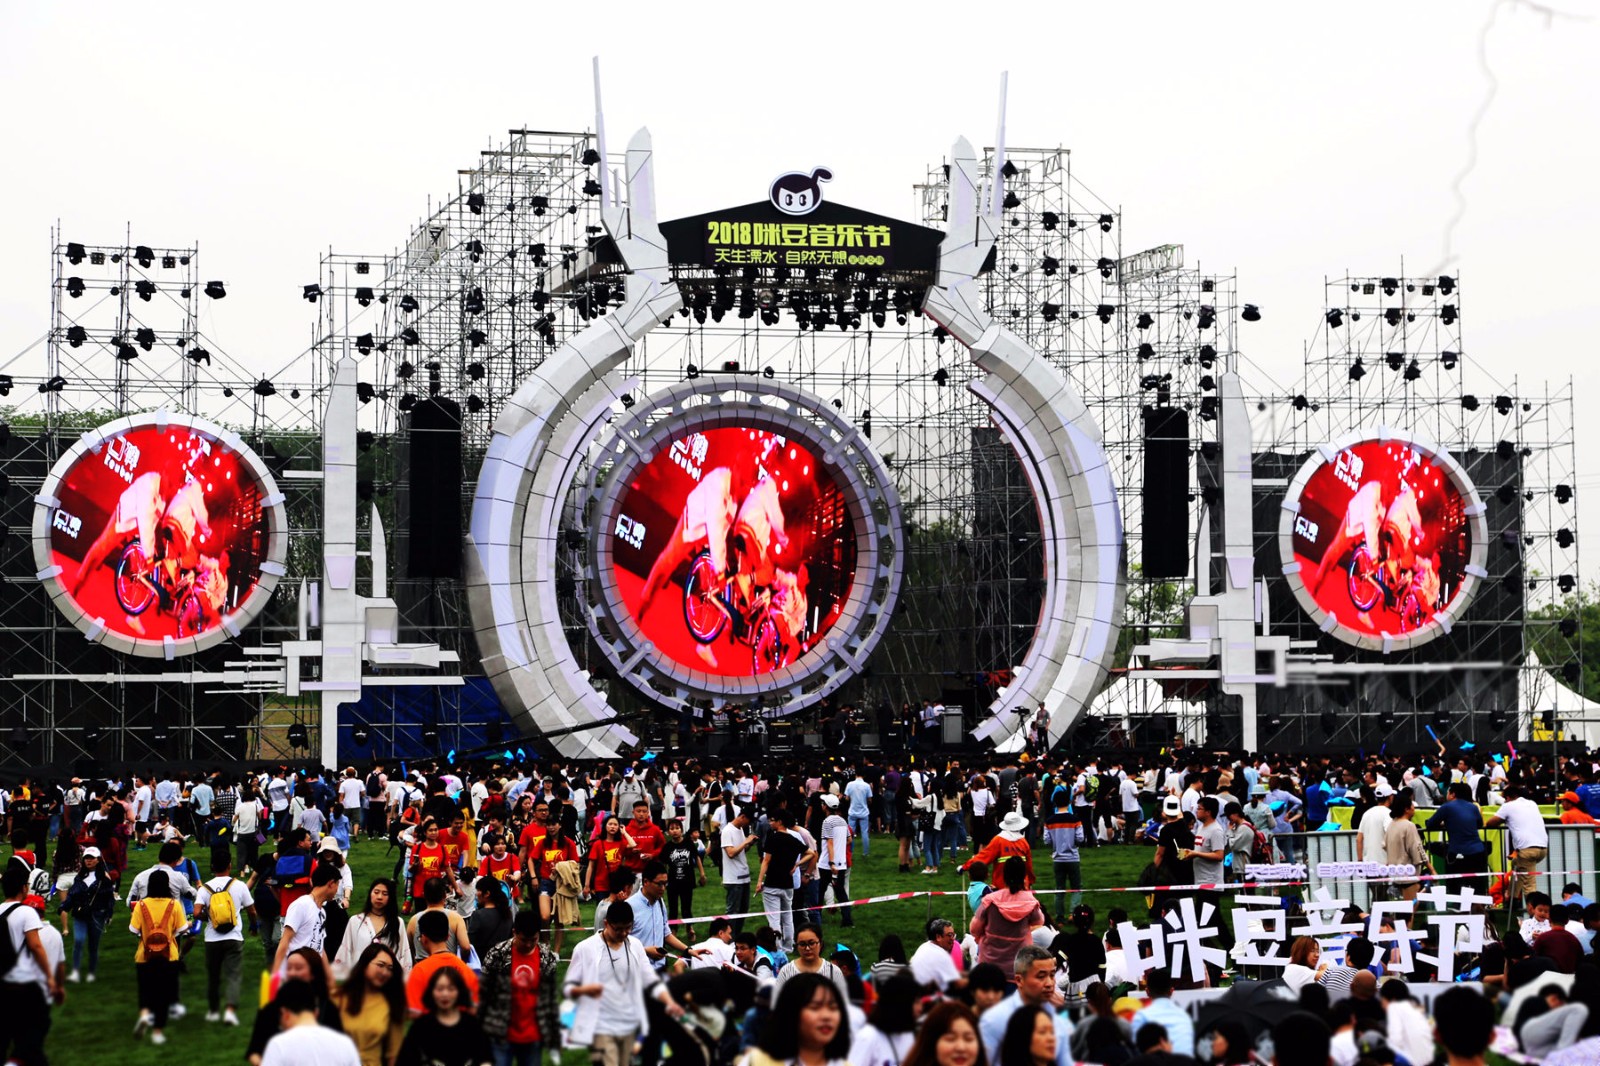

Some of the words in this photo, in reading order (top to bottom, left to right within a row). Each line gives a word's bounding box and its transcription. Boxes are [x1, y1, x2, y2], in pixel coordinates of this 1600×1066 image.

[707, 221, 891, 248] 2018咪豆音乐节
[1116, 886, 1493, 982] 咪豆音乐节
